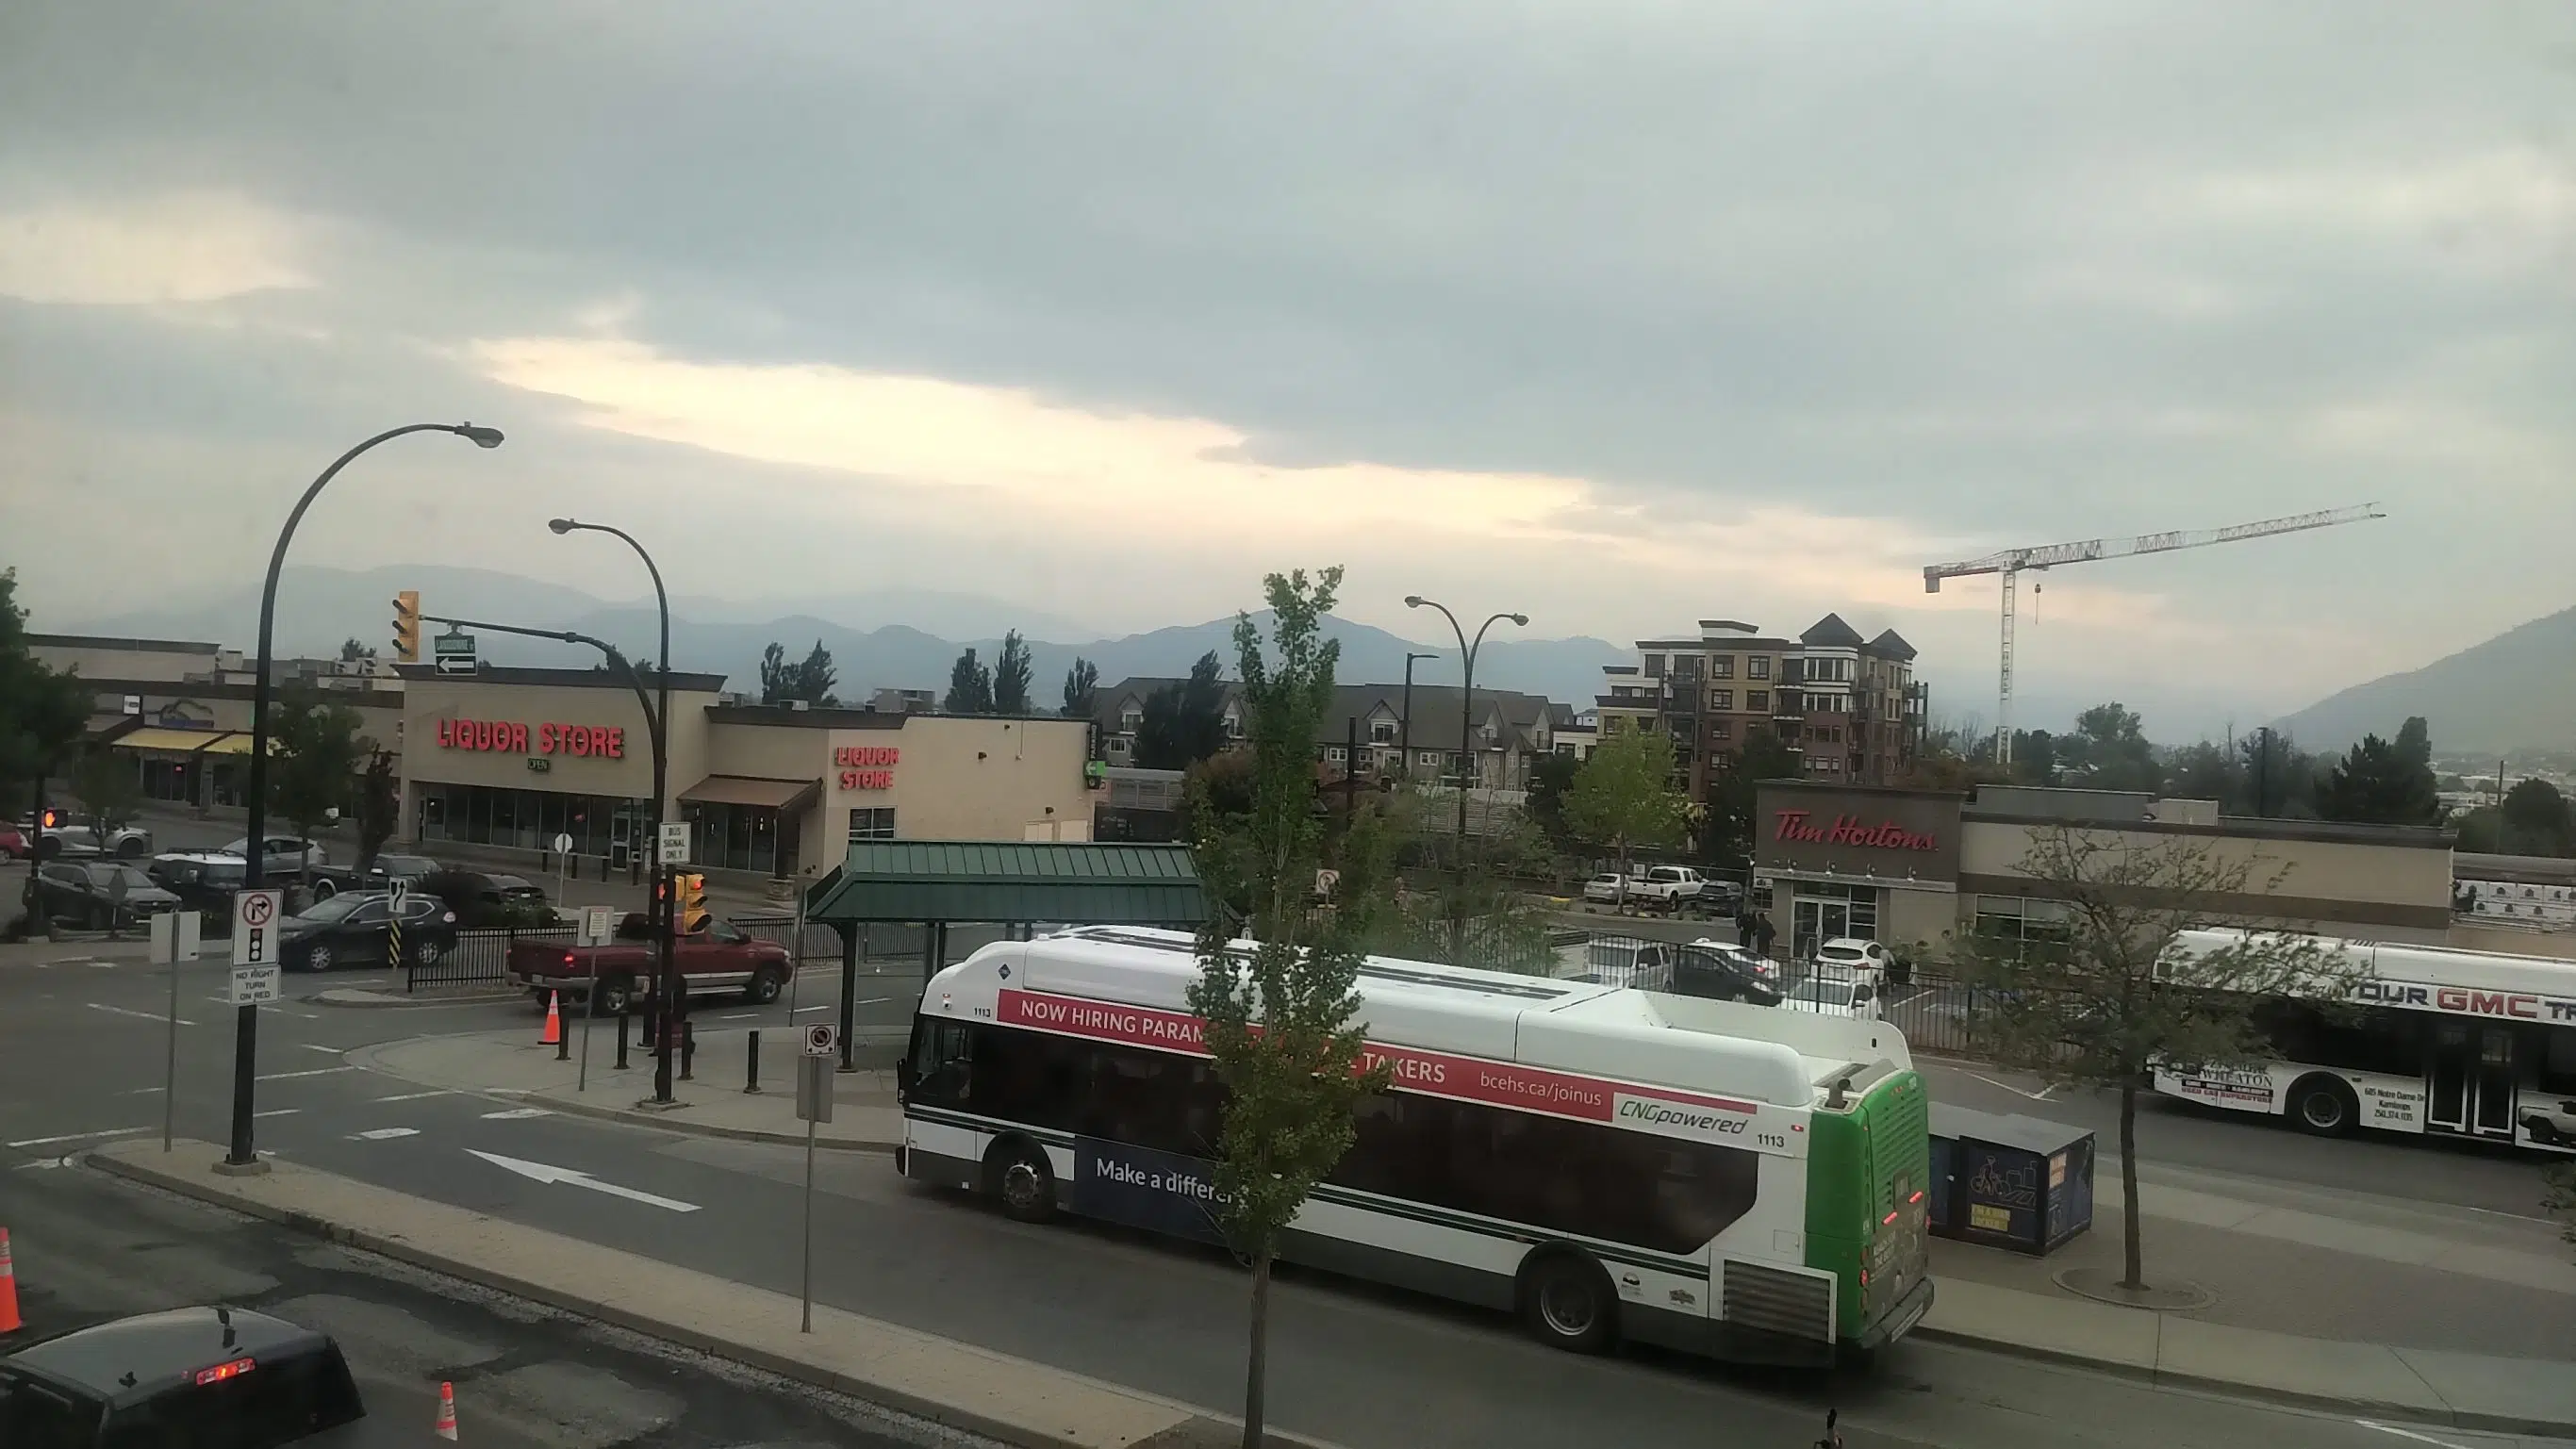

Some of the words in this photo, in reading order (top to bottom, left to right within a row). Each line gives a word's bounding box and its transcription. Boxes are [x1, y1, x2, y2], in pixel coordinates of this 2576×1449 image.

[438, 718, 528, 752] LIQUOR
[539, 722, 623, 758] STORE
[837, 746, 900, 766] LIQUOR
[843, 769, 894, 789] STORE
[668, 827, 681, 836] BUS
[1774, 808, 1825, 843] Tim
[1827, 812, 1937, 849] Hortons
[663, 838, 685, 848] SIGNAL
[666, 850, 683, 859] ONLY
[250, 970, 274, 979] RIGHT
[245, 981, 266, 990] TURN
[974, 1007, 991, 1018] 1113
[2436, 987, 2538, 1019] GMC
[1021, 999, 1066, 1023] NOW
[1071, 1007, 1136, 1033] HIRING
[1480, 1071, 1602, 1107] bcehs.ca/joinus
[1619, 1099, 1748, 1135] CNGpowered
[1757, 1133, 1785, 1148] 1113
[1096, 1158, 1146, 1186] Make
[1150, 1173, 1161, 1189] a
